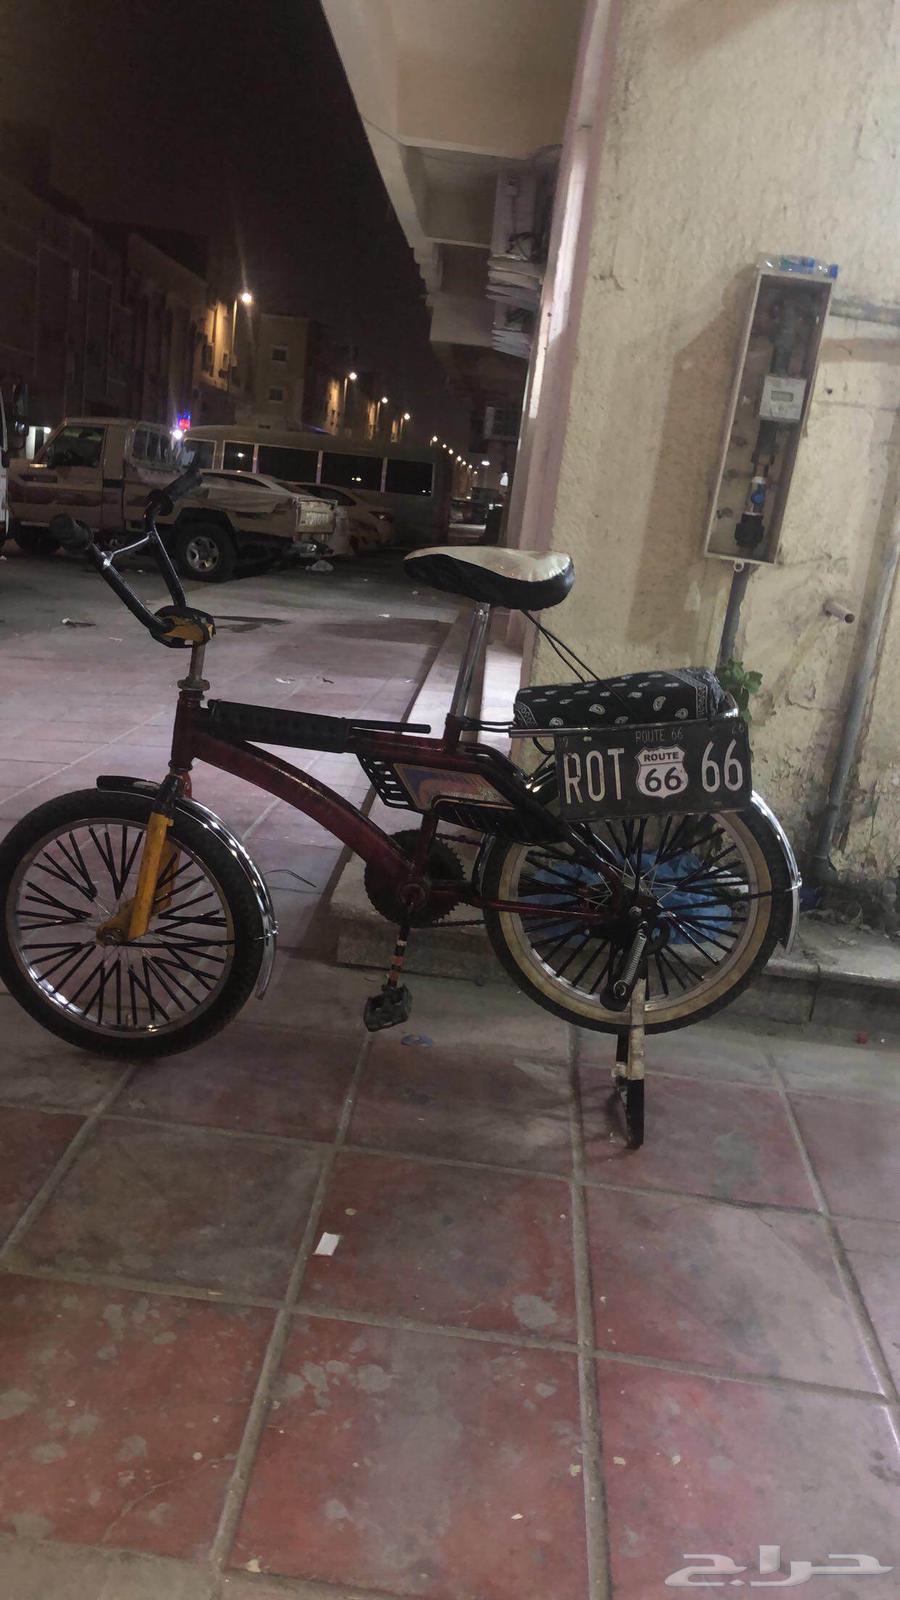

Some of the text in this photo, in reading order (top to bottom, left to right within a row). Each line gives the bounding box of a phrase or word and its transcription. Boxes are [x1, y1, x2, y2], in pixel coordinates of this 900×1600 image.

[635, 728, 684, 744] ROUTE 66
[643, 751, 680, 761] ROUTE
[563, 739, 743, 804] ROT 66
[645, 767, 682, 792] 66
